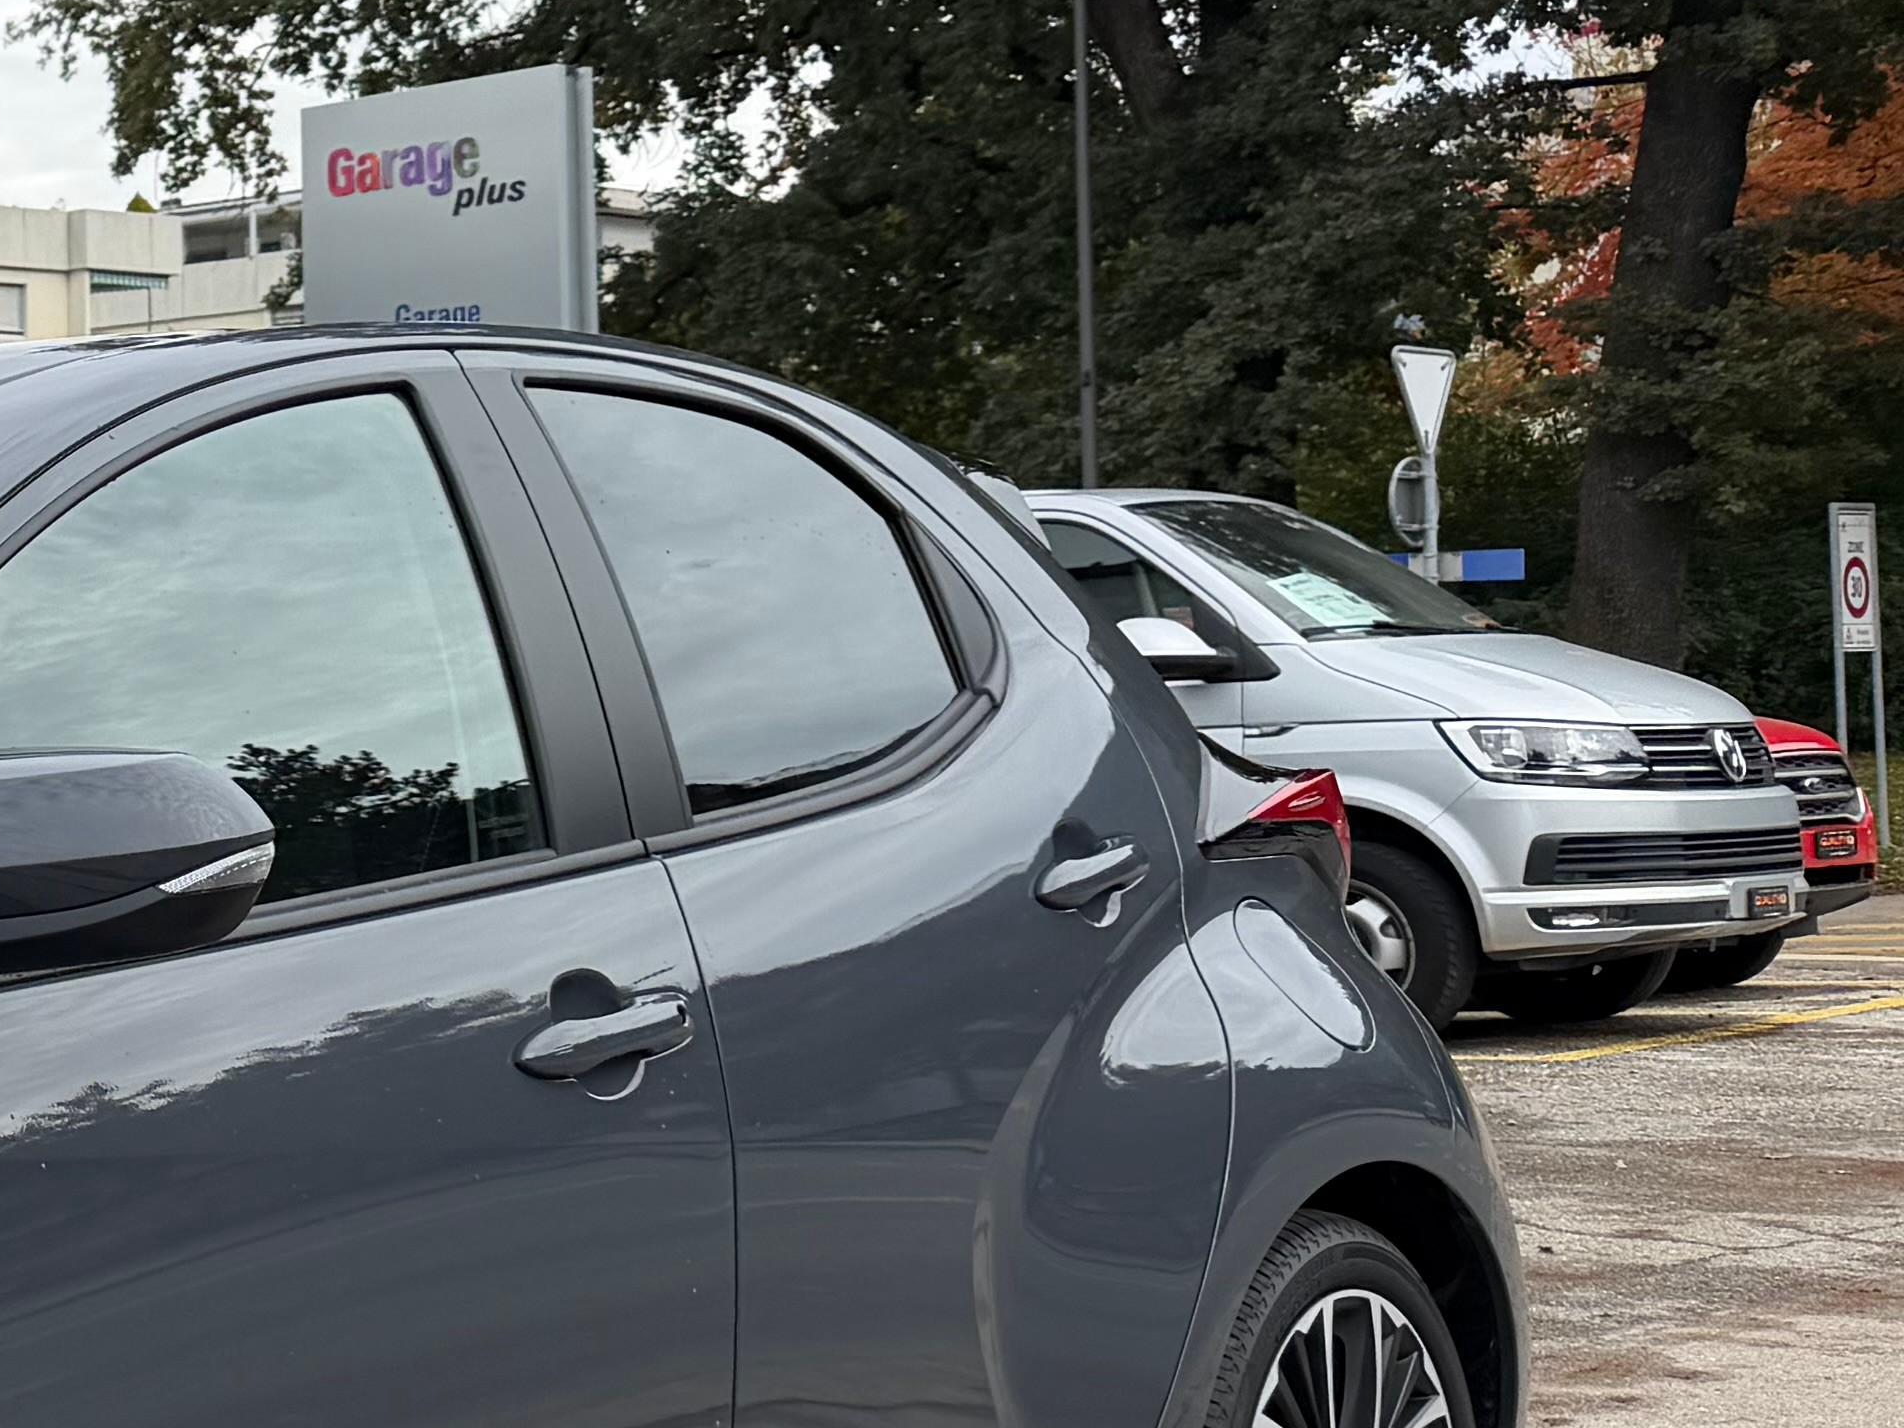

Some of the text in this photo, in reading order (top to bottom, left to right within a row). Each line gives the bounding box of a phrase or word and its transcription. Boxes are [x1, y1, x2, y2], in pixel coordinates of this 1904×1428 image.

[327, 133, 480, 198] Garage
[452, 176, 527, 216] plus
[1850, 575, 1863, 598] 30
